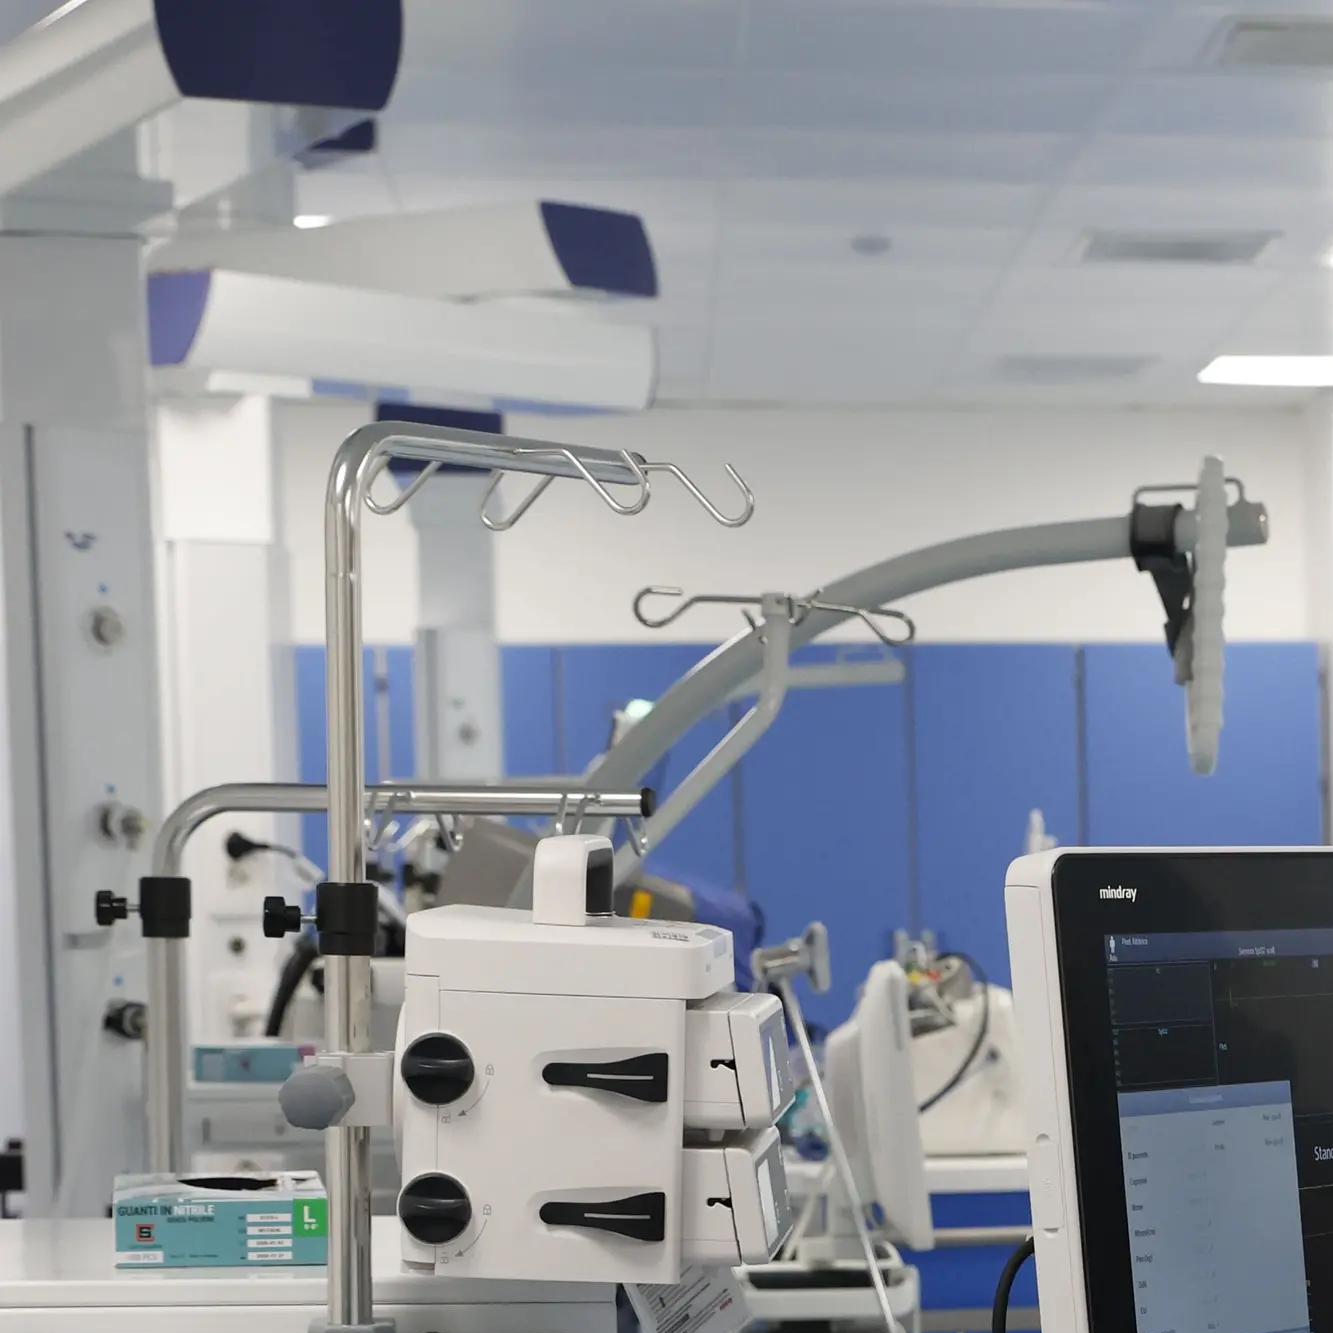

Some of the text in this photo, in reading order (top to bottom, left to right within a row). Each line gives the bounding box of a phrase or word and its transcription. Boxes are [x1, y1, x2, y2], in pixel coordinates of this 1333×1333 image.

[1100, 885, 1137, 902] mindray
[118, 1204, 215, 1216] GUANTI IN NITRILE
[303, 1206, 316, 1222] L
